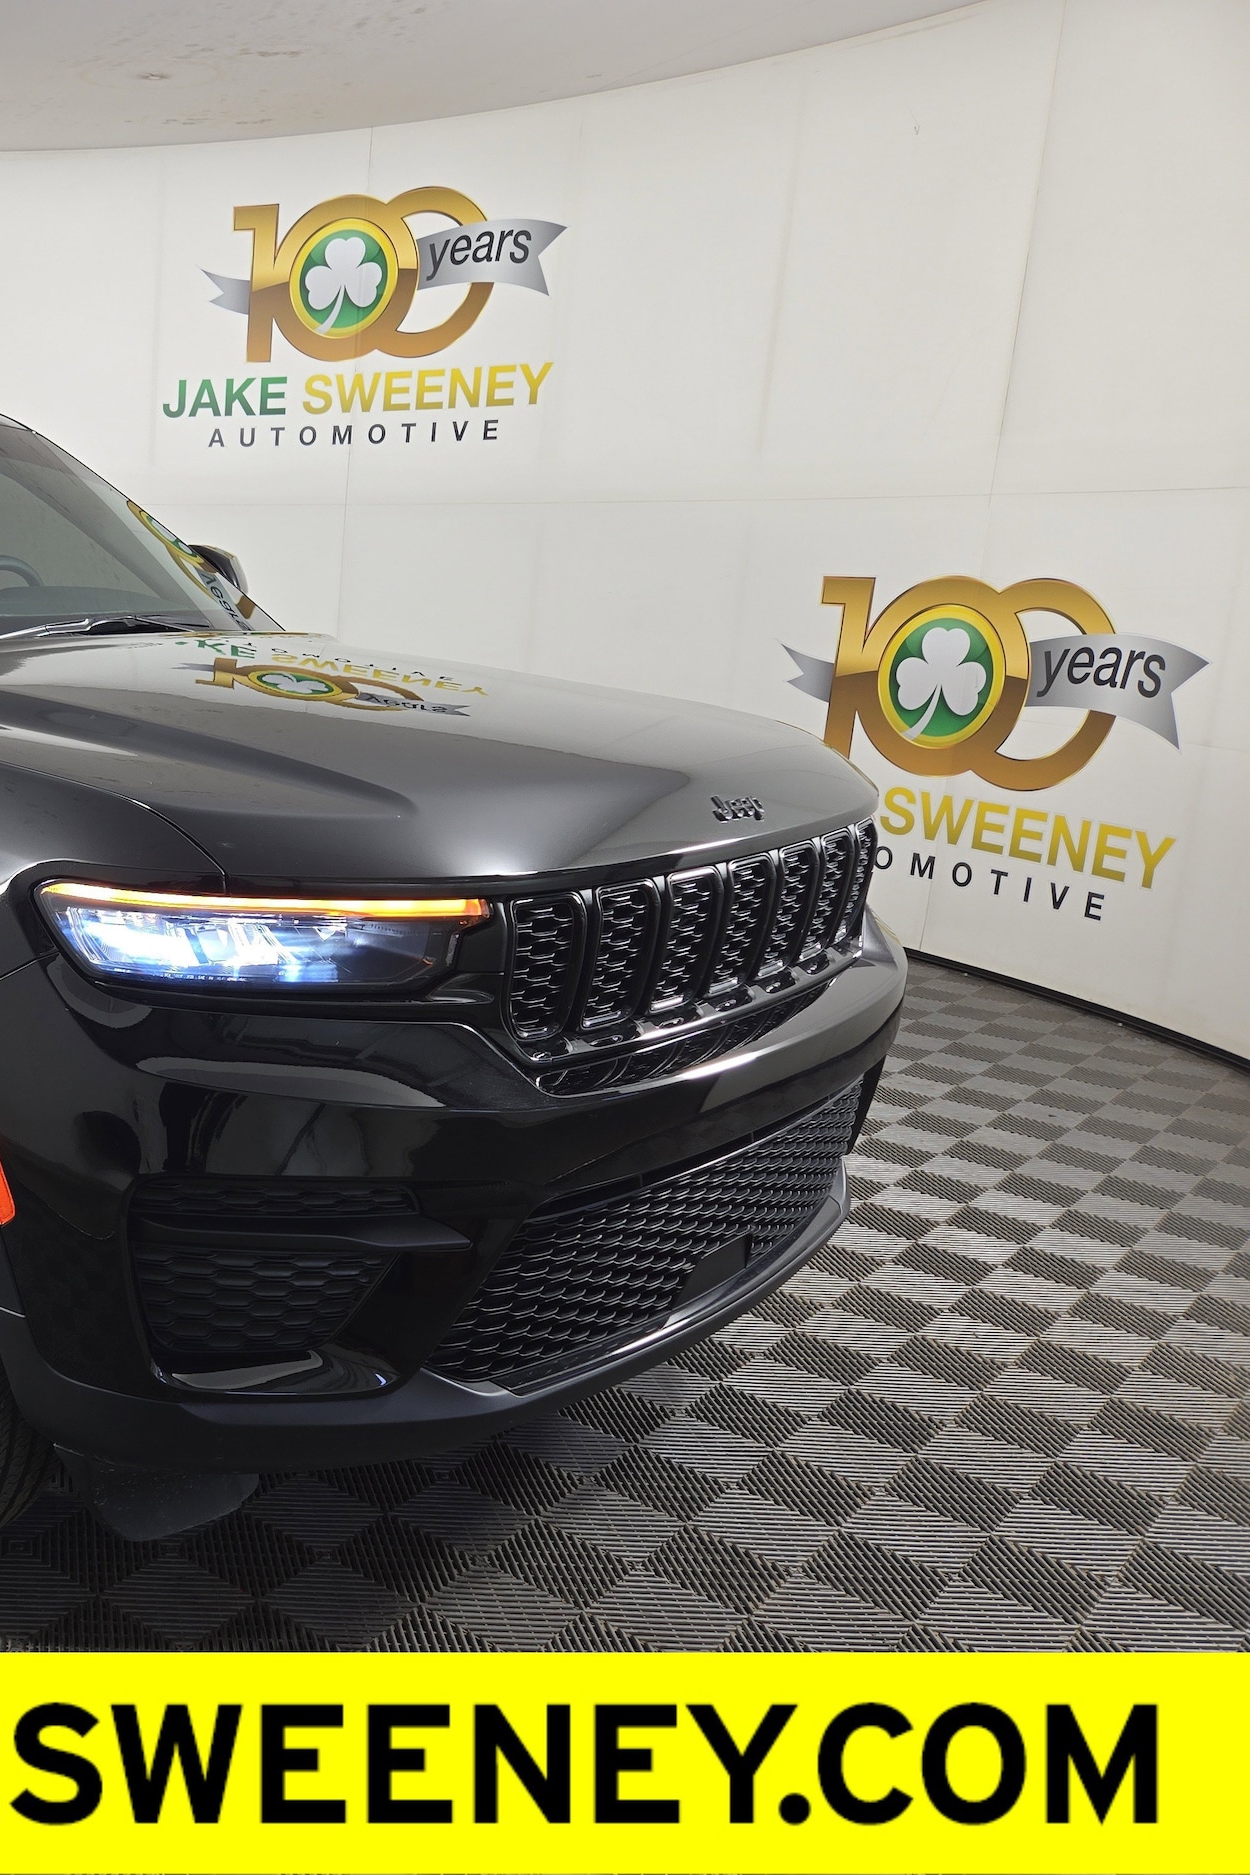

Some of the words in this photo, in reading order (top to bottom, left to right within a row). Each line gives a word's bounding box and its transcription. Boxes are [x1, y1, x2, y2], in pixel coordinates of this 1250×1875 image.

[426, 229, 532, 281] years
[163, 376, 287, 418] JAKE
[302, 362, 554, 415] SWEENEY
[208, 419, 499, 448] AUTOMOTIVE
[1036, 647, 1166, 698] years
[880, 787, 1176, 889] SWEENEY
[875, 846, 1106, 920] OMOTIVE
